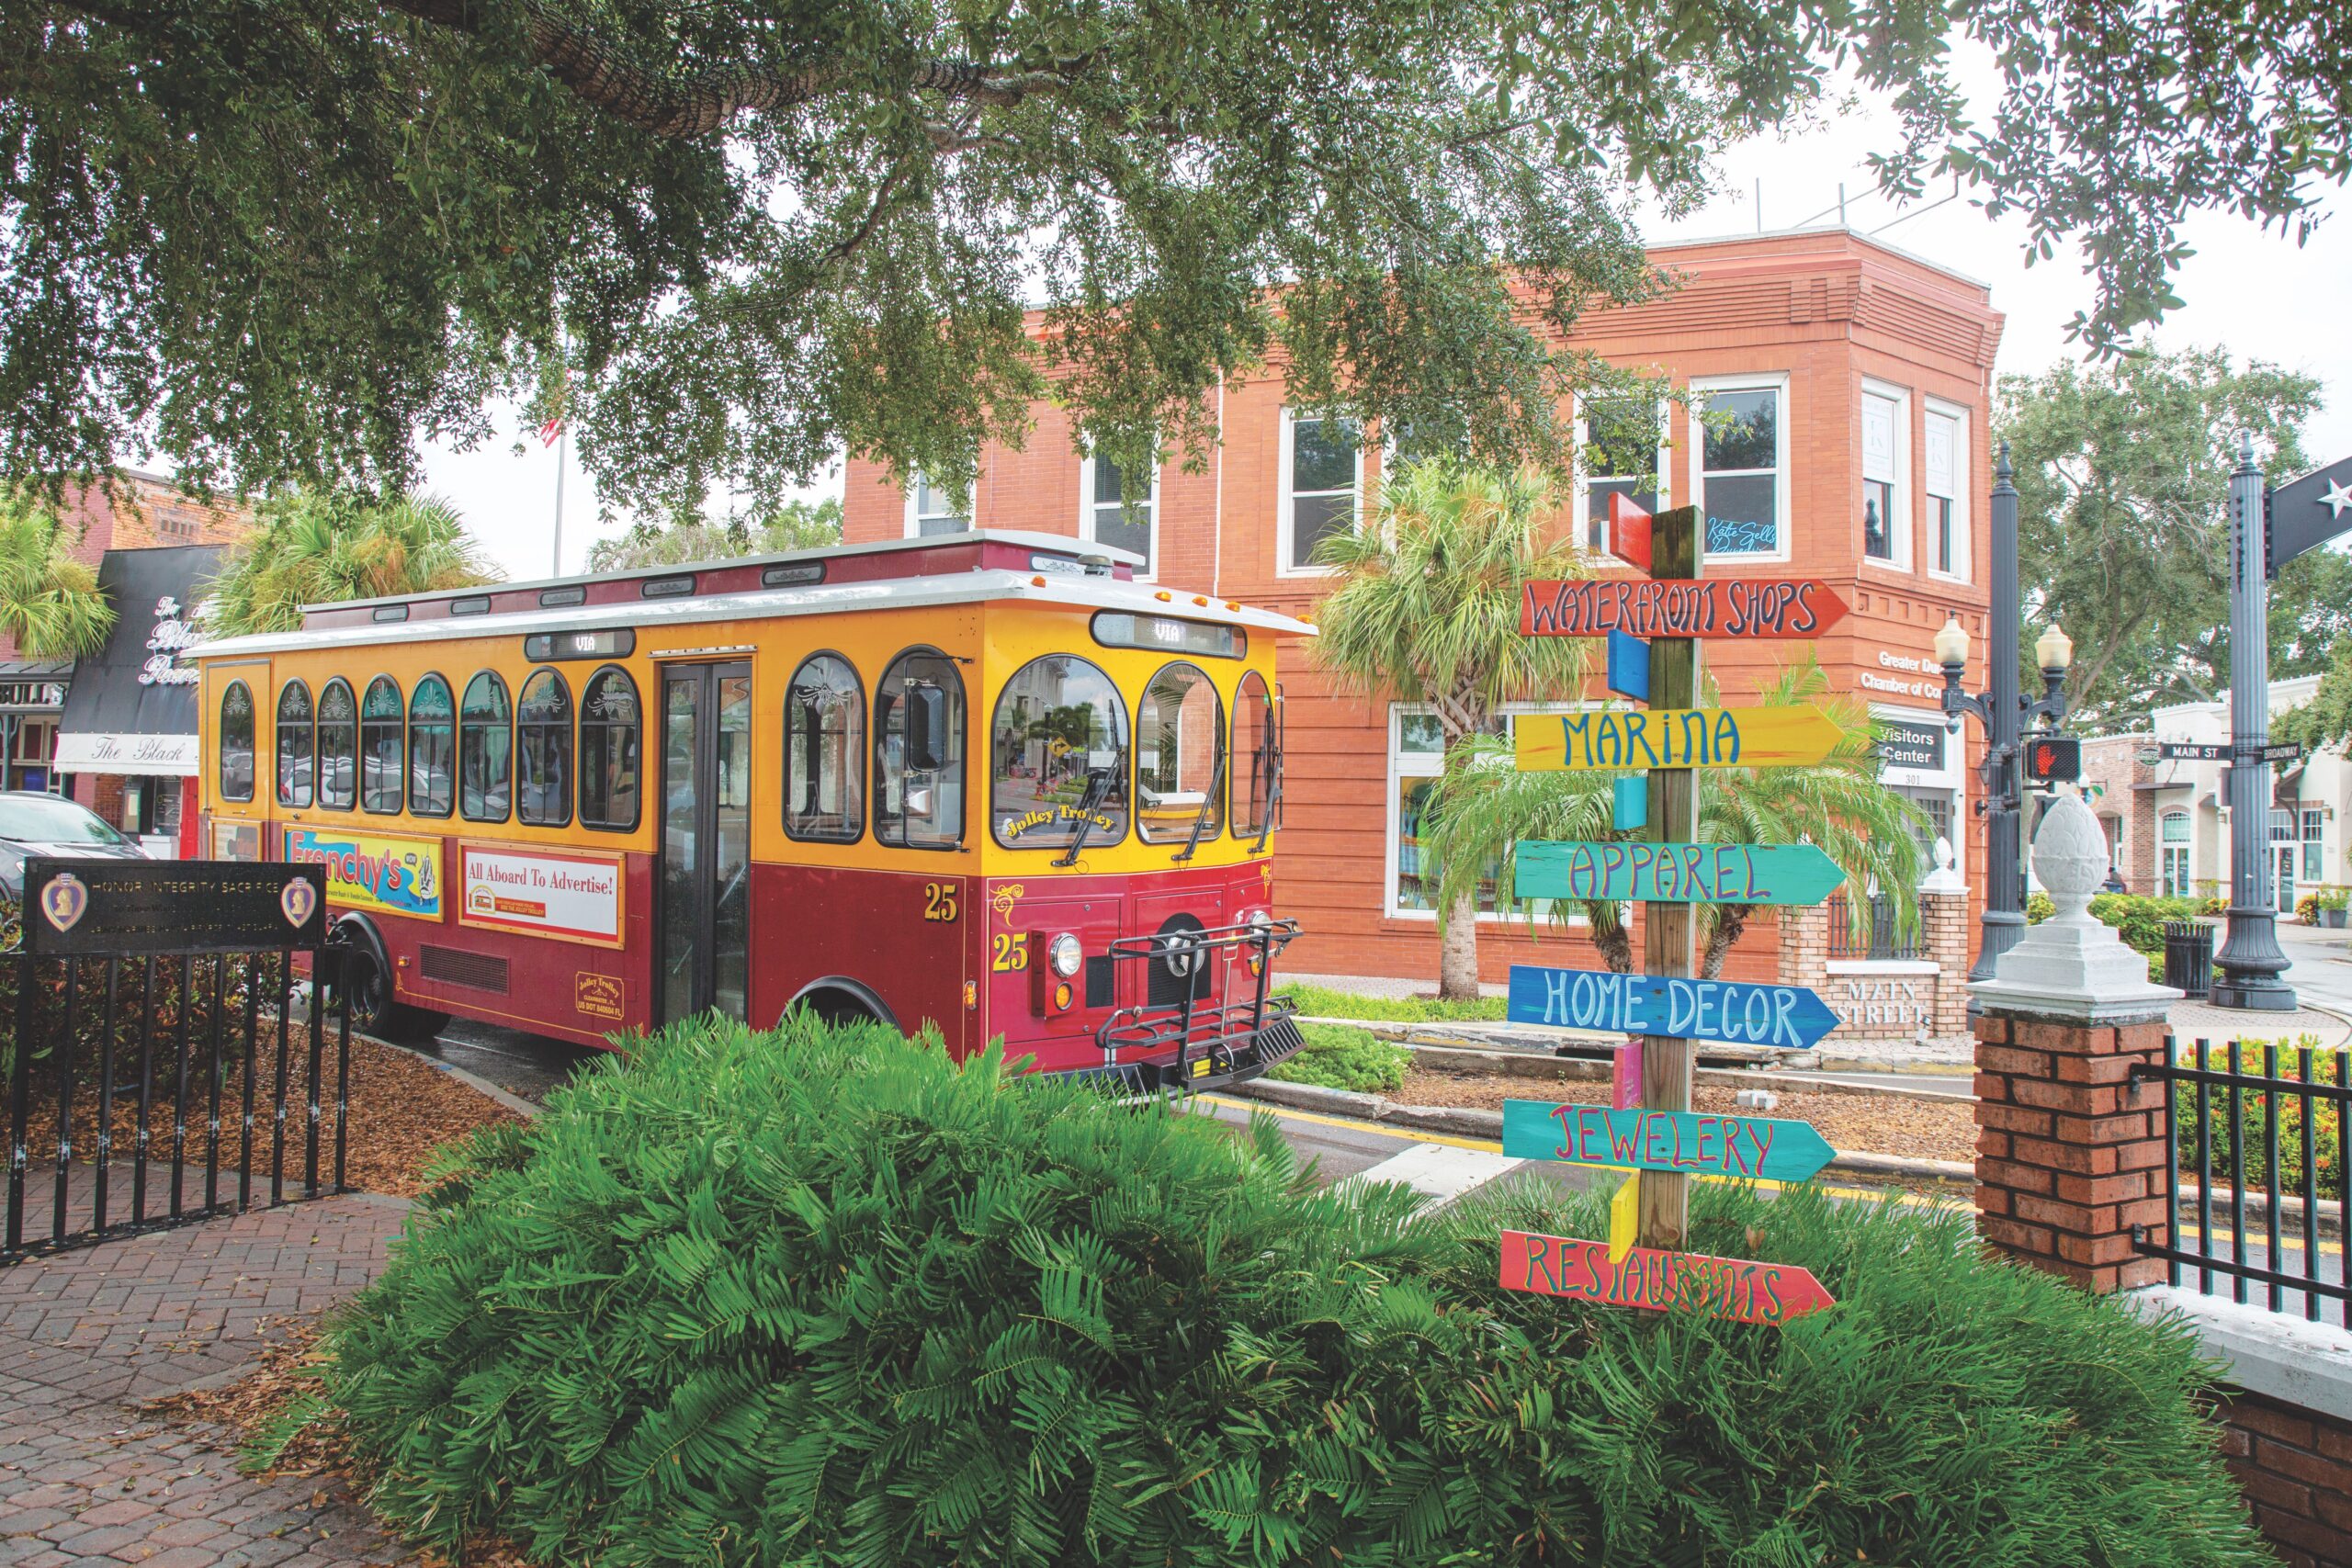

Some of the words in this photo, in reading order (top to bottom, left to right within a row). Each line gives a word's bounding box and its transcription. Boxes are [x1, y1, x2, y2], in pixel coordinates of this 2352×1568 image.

[1708, 517, 1739, 540] Katie
[1739, 522, 1776, 546] Sells
[1527, 581, 1716, 634] WATERFRONT
[1725, 581, 1817, 636] SHOPS
[1154, 624, 1181, 642] VIA
[575, 637, 595, 651] VIA
[1879, 651, 1920, 671] Greater
[1860, 672, 1909, 694] Chamber
[1911, 682, 1923, 696] of
[1880, 727, 1934, 746] Visitors
[91, 736, 122, 760] The
[132, 738, 187, 761] Black
[1884, 746, 1931, 763] Center
[2172, 746, 2199, 758] MAIN
[2204, 748, 2219, 759] ST
[2264, 745, 2298, 760] BROADWAY
[1905, 774, 1920, 785] 301
[1007, 809, 1056, 838] Jolley
[469, 862, 483, 880] All
[486, 864, 527, 886] Aboard
[530, 868, 547, 888] To
[549, 871, 614, 896] Advertise!
[1569, 844, 1771, 900] APPAREL
[220, 881, 279, 894] SACRFCE
[924, 883, 957, 921] 25
[992, 931, 1028, 972] 25
[580, 978, 596, 990] Jolley
[598, 977, 619, 998] Trolley
[1848, 981, 1917, 1001] MAIN
[1544, 970, 1648, 1030] HOME
[1667, 979, 1804, 1048] DECOR
[1838, 1005, 1927, 1024] STREET
[1550, 1104, 1773, 1177] JEWELERY
